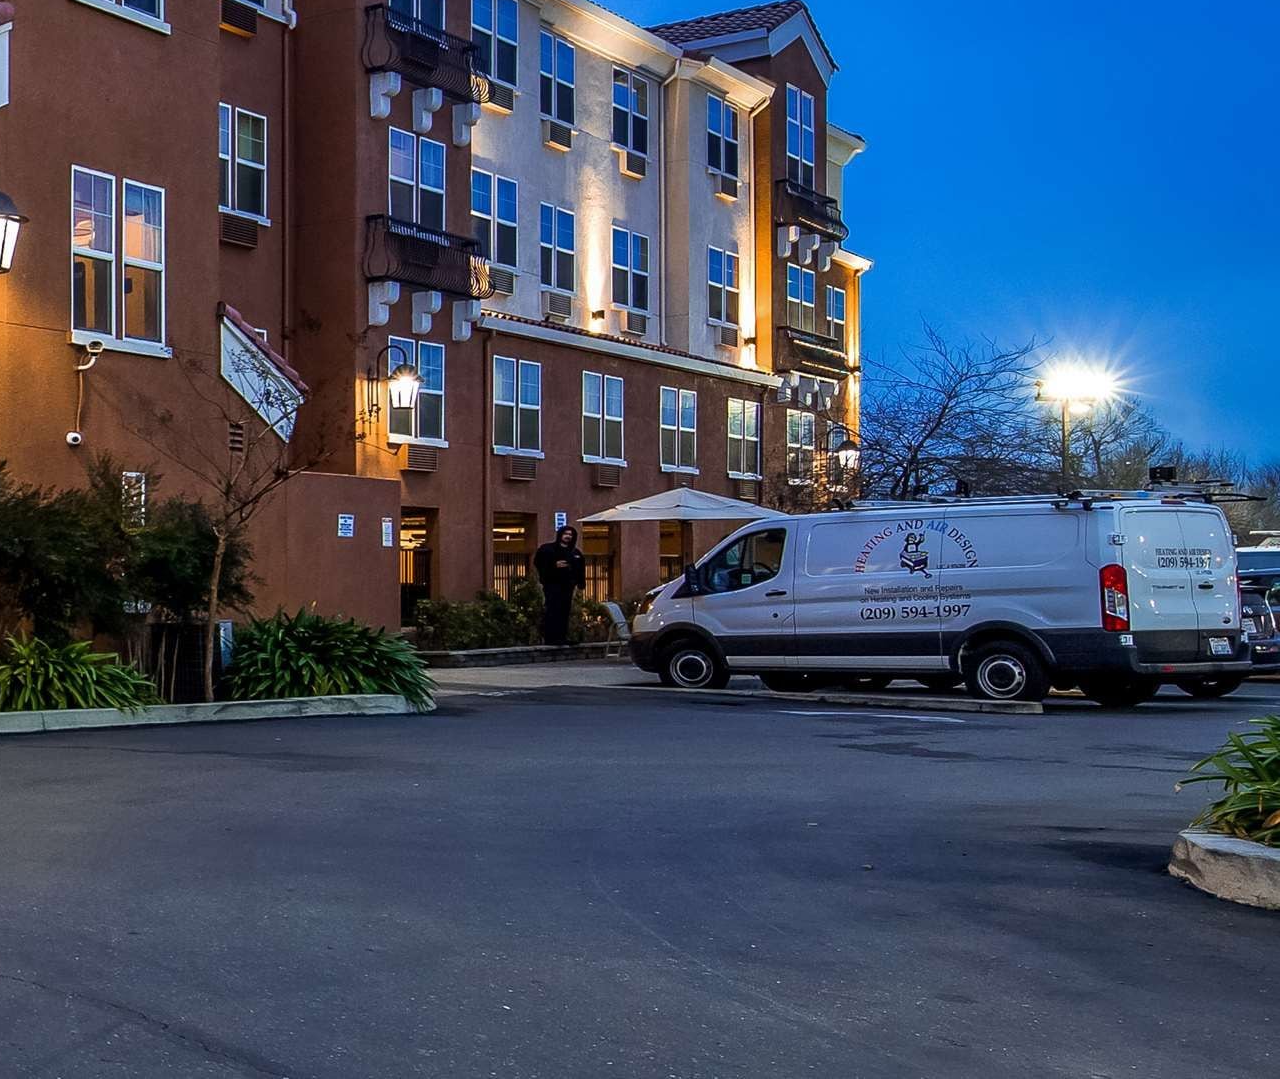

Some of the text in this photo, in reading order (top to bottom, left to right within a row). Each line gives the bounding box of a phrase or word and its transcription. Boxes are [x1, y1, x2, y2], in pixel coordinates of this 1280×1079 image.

[854, 519, 979, 573] HEATING AND AIR DESIGN
[1157, 557, 1178, 569] (209)
[864, 587, 879, 595] New
[920, 584, 934, 593] and
[860, 604, 971, 620] (209) 594-1997
